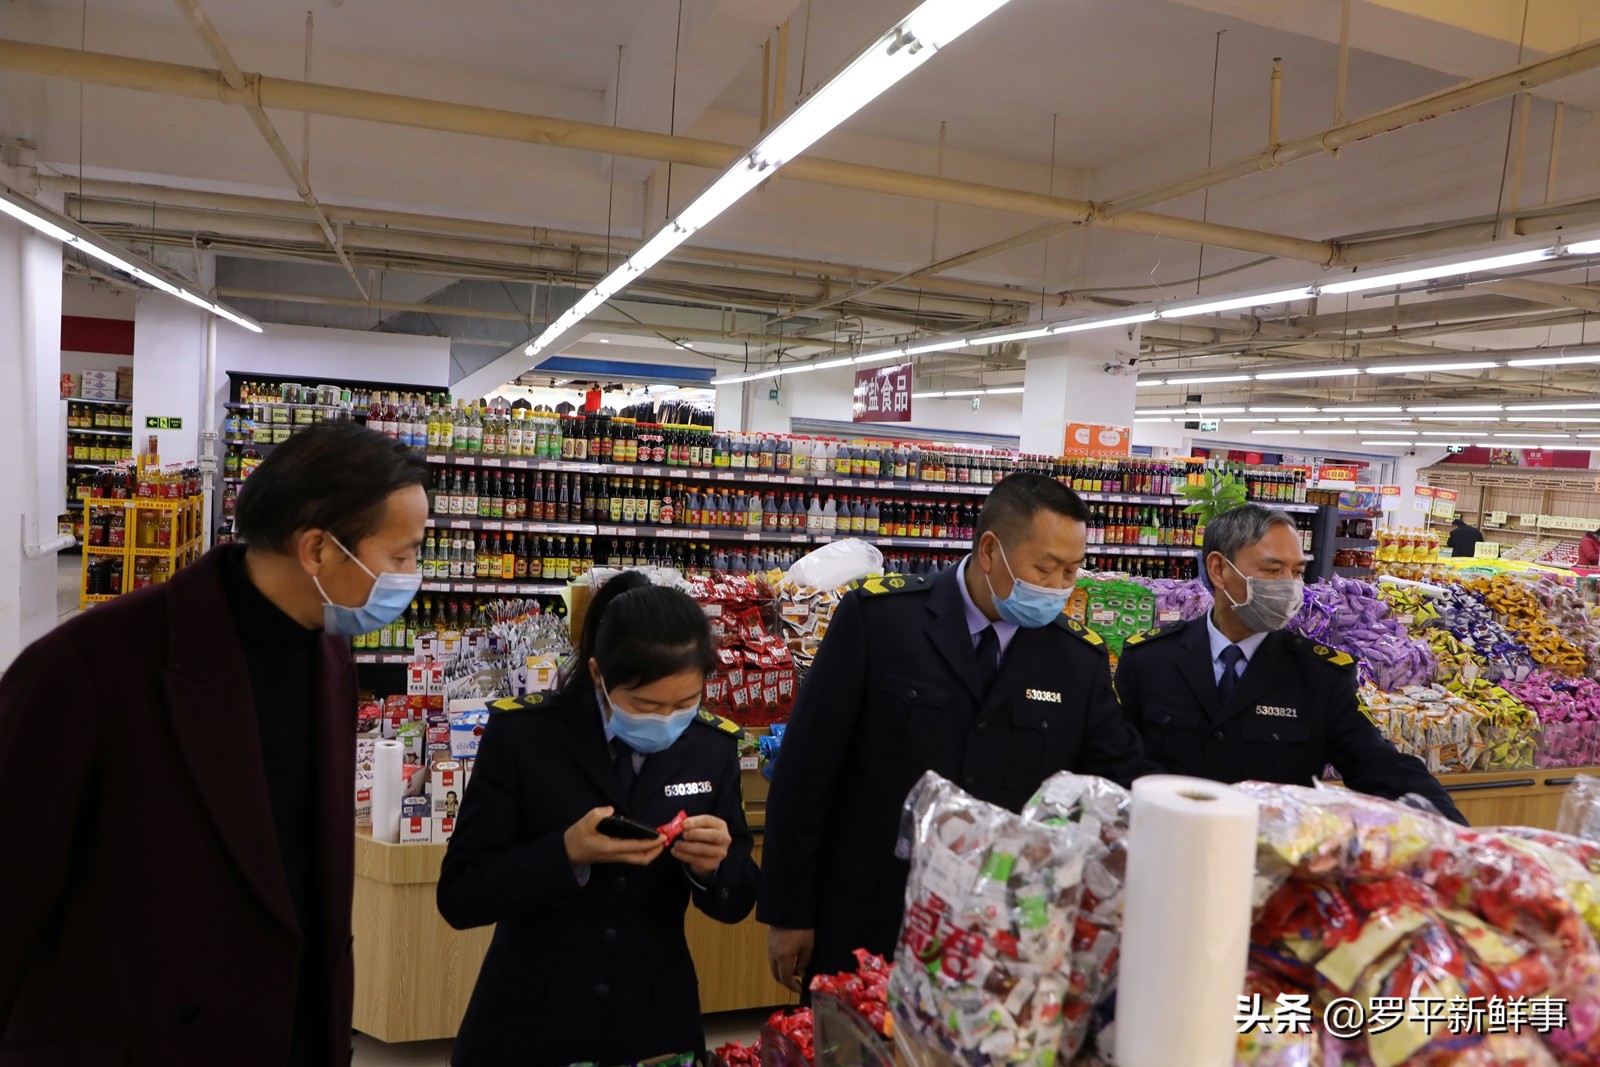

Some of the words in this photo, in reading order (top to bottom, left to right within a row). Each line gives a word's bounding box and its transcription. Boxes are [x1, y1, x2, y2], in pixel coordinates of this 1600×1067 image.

[1025, 688, 1062, 703] 5303834
[1255, 705, 1298, 718] 5303821
[664, 781, 712, 797] 5303836
